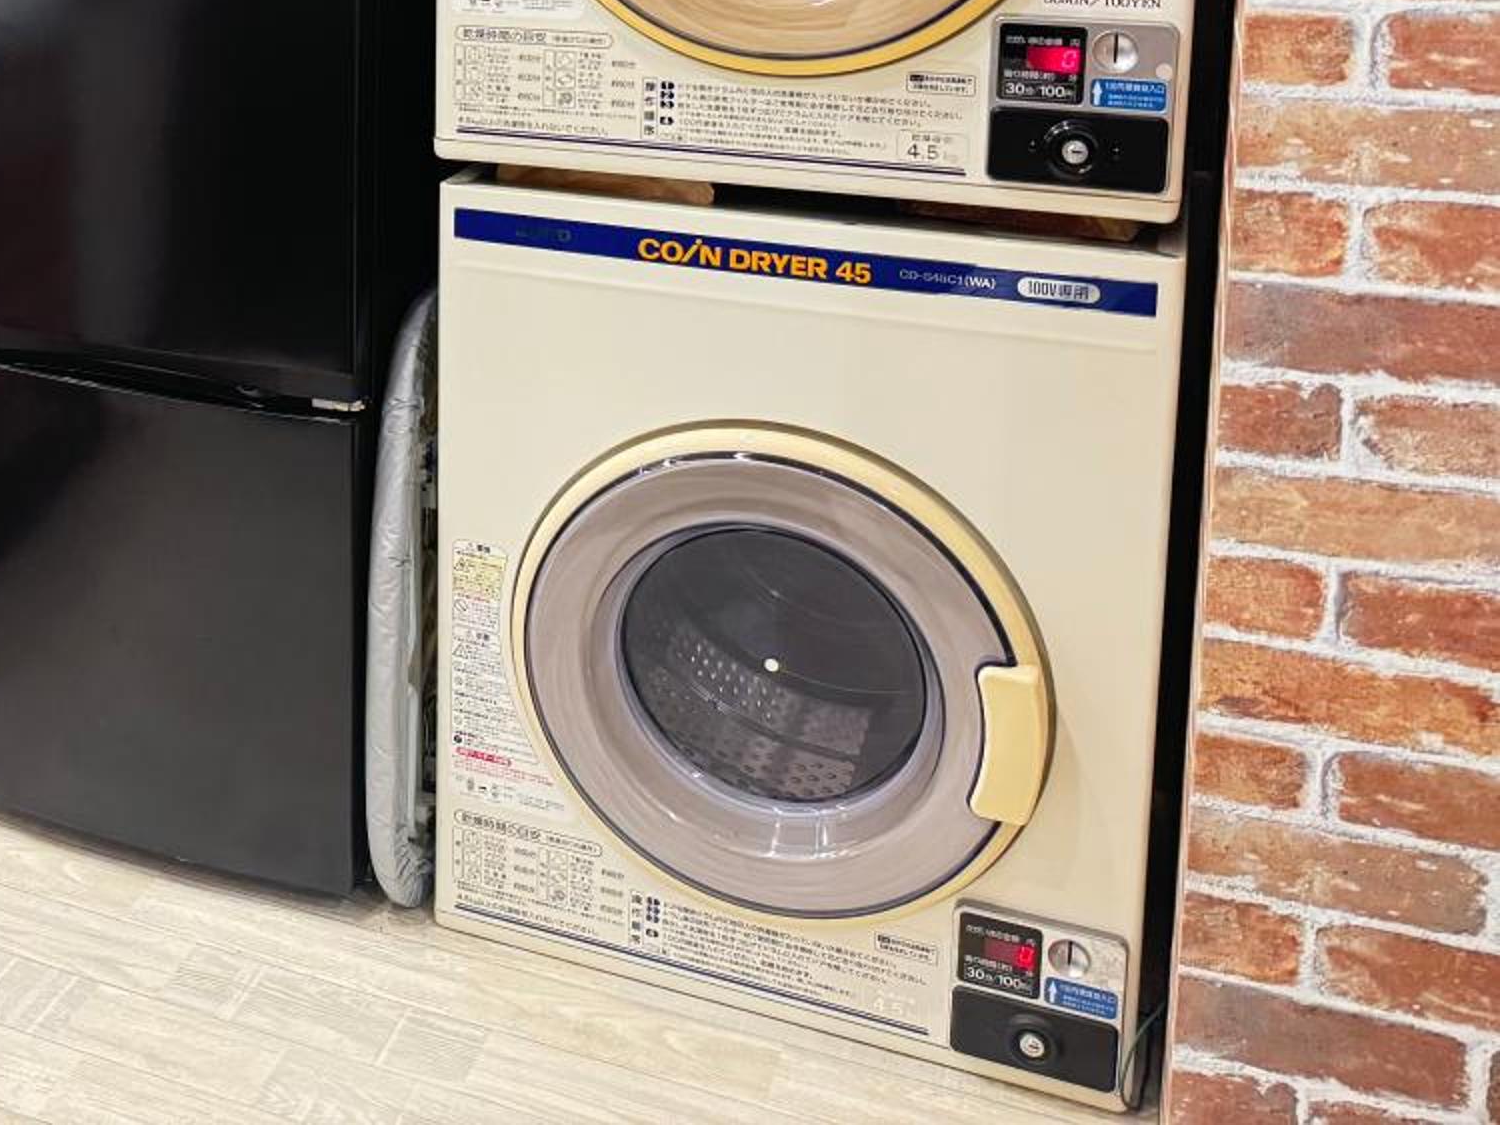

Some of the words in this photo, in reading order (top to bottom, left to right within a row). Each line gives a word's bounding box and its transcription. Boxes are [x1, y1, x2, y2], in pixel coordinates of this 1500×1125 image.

[637, 236, 722, 267] COIN
[729, 248, 828, 280] DRYER
[835, 260, 872, 285] 45
